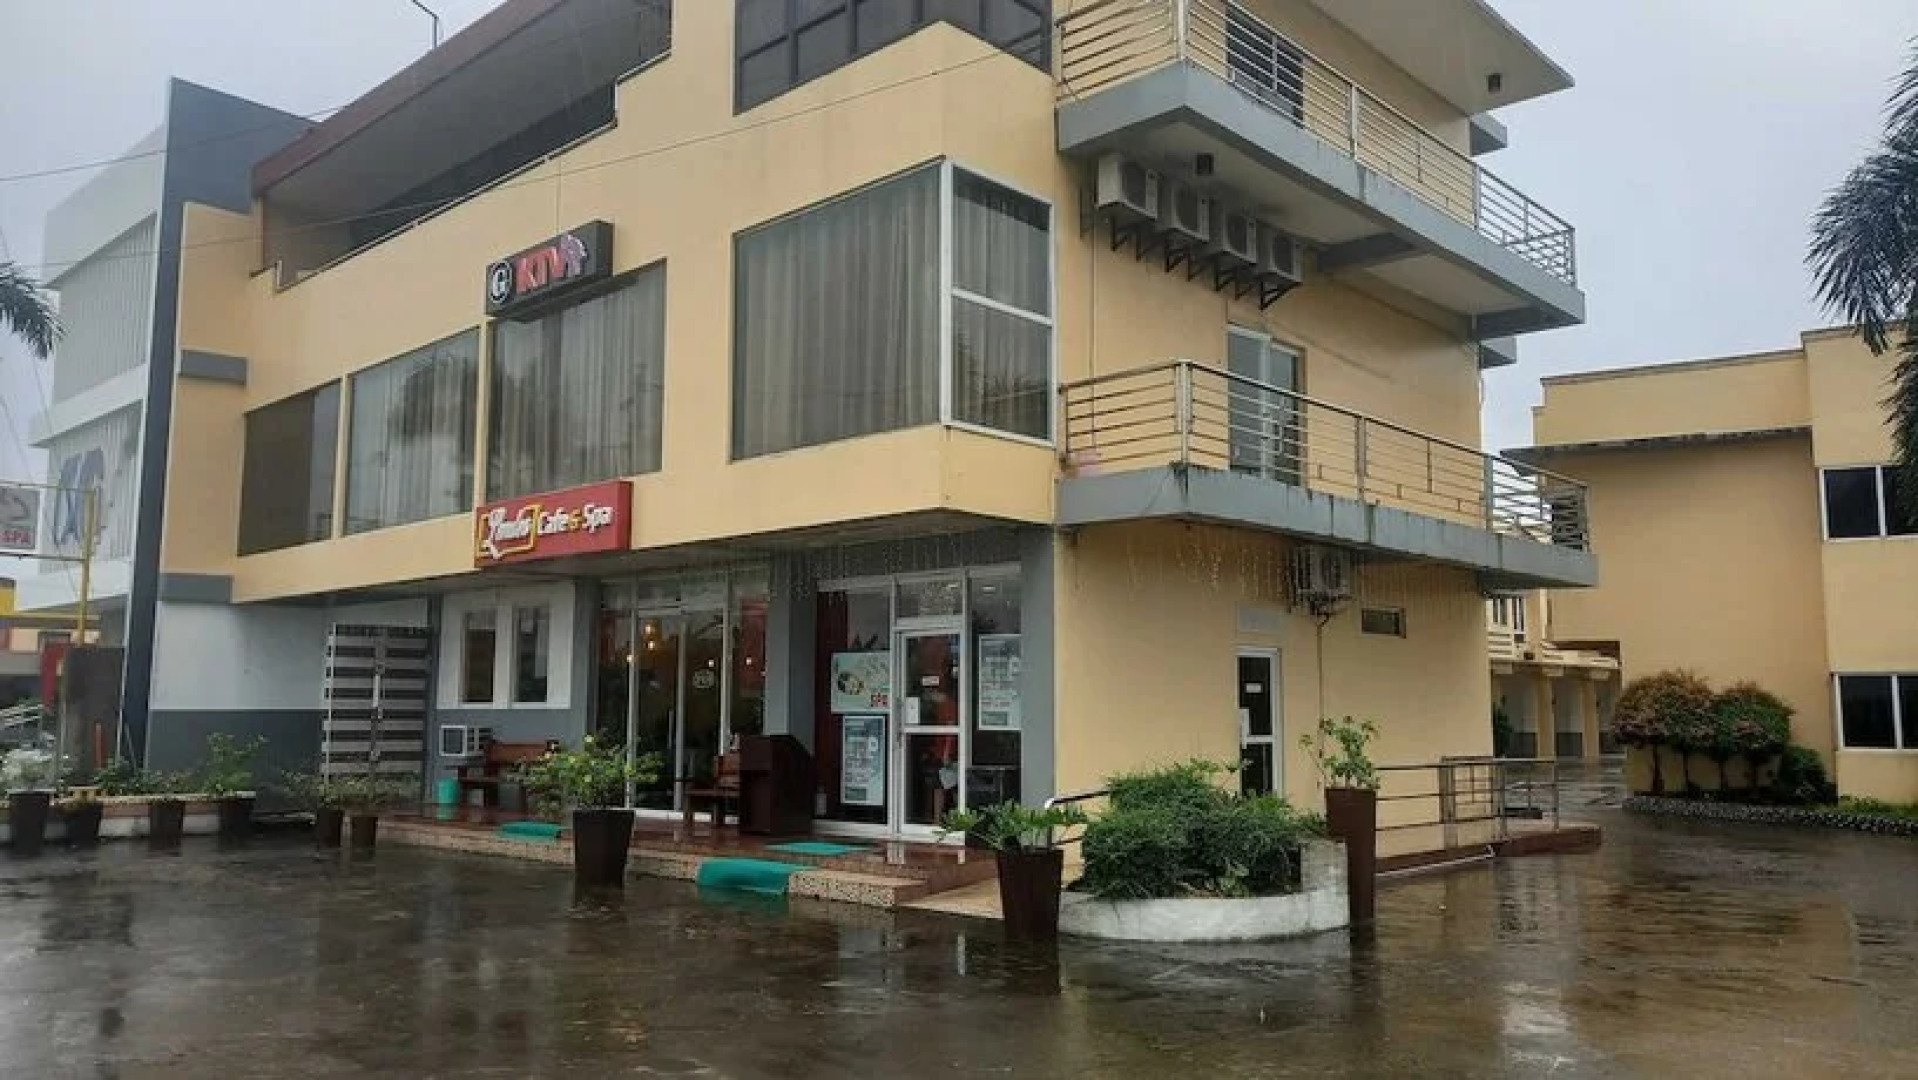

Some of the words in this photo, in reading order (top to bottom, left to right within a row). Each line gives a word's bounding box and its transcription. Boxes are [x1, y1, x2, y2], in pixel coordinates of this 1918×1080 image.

[515, 246, 566, 294] KTV
[537, 506, 569, 536] Cafe
[583, 503, 614, 534] Spa
